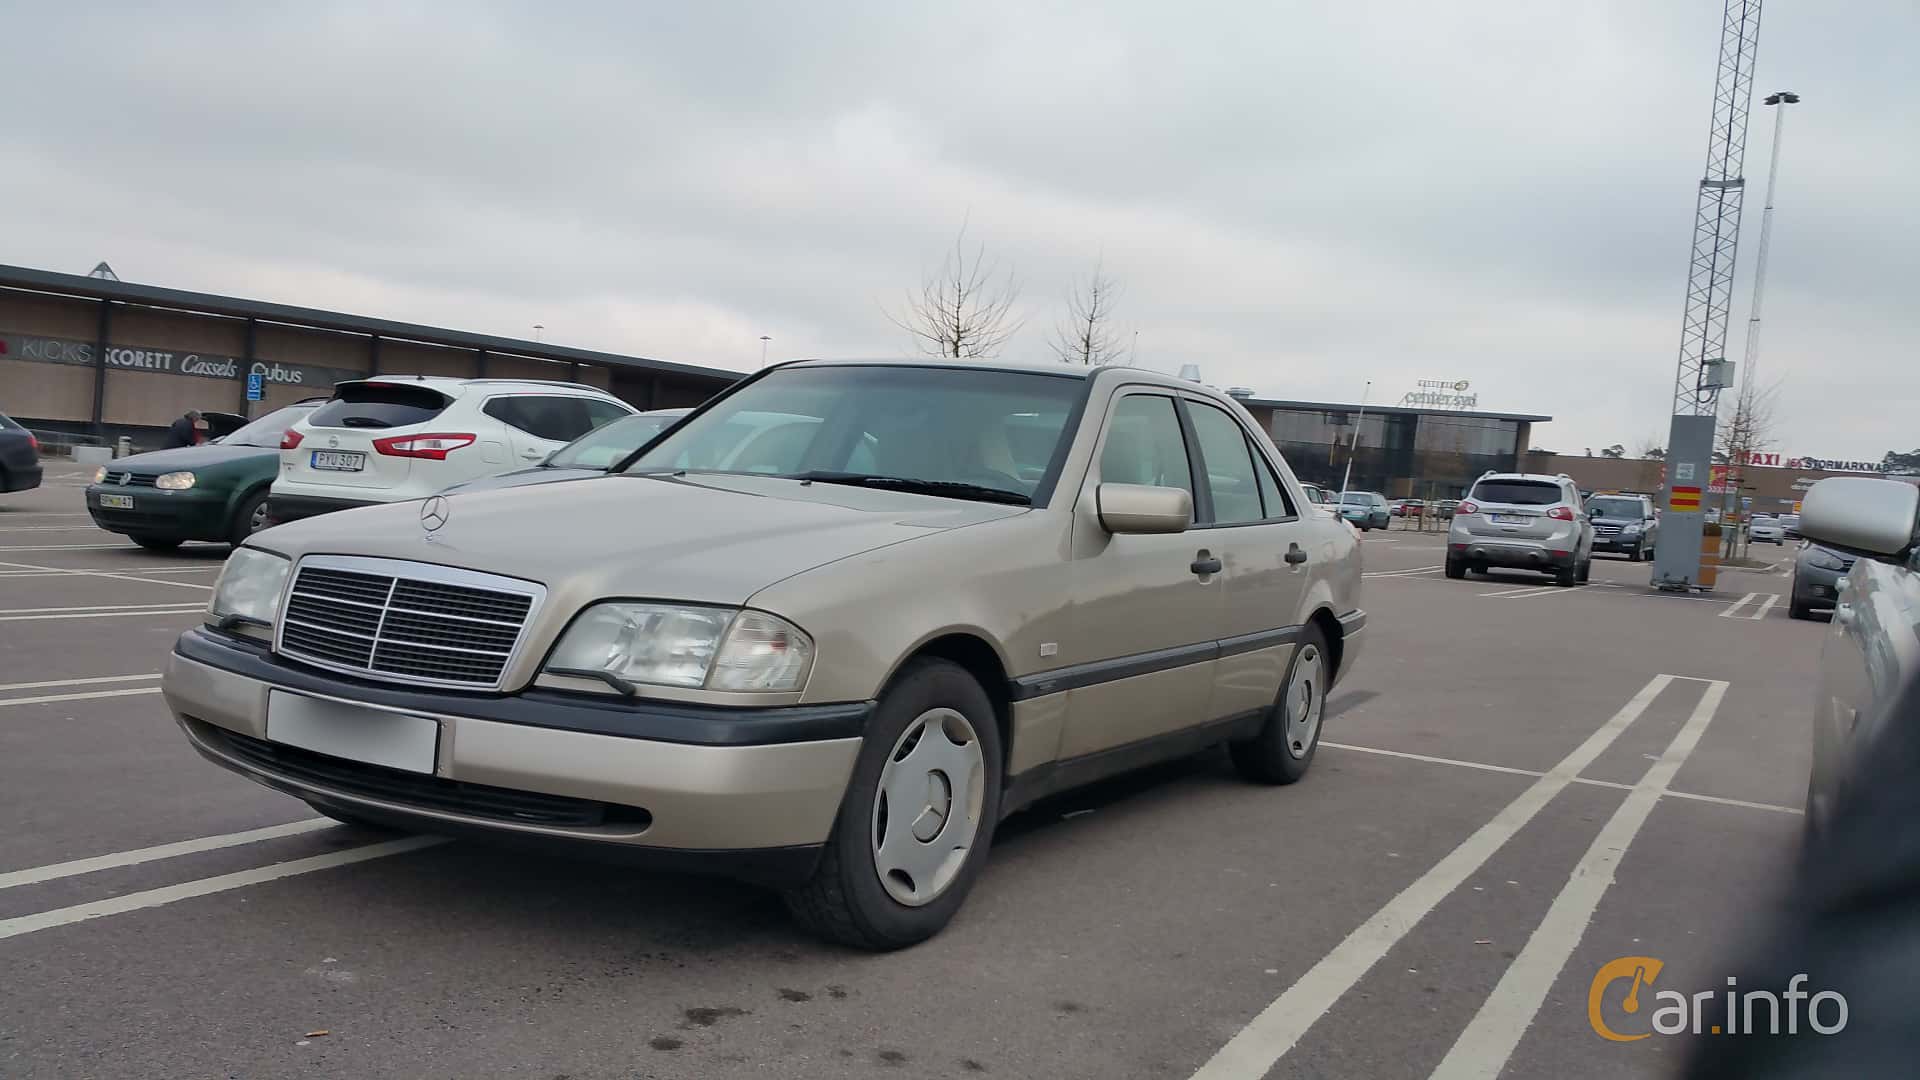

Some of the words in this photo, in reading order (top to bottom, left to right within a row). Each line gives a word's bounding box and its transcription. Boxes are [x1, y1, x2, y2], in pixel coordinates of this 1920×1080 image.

[22, 339, 91, 363] KICKS
[180, 354, 237, 377] Cassels
[251, 362, 302, 383] Cubus
[318, 453, 338, 466] PYU
[339, 455, 360, 468] 307
